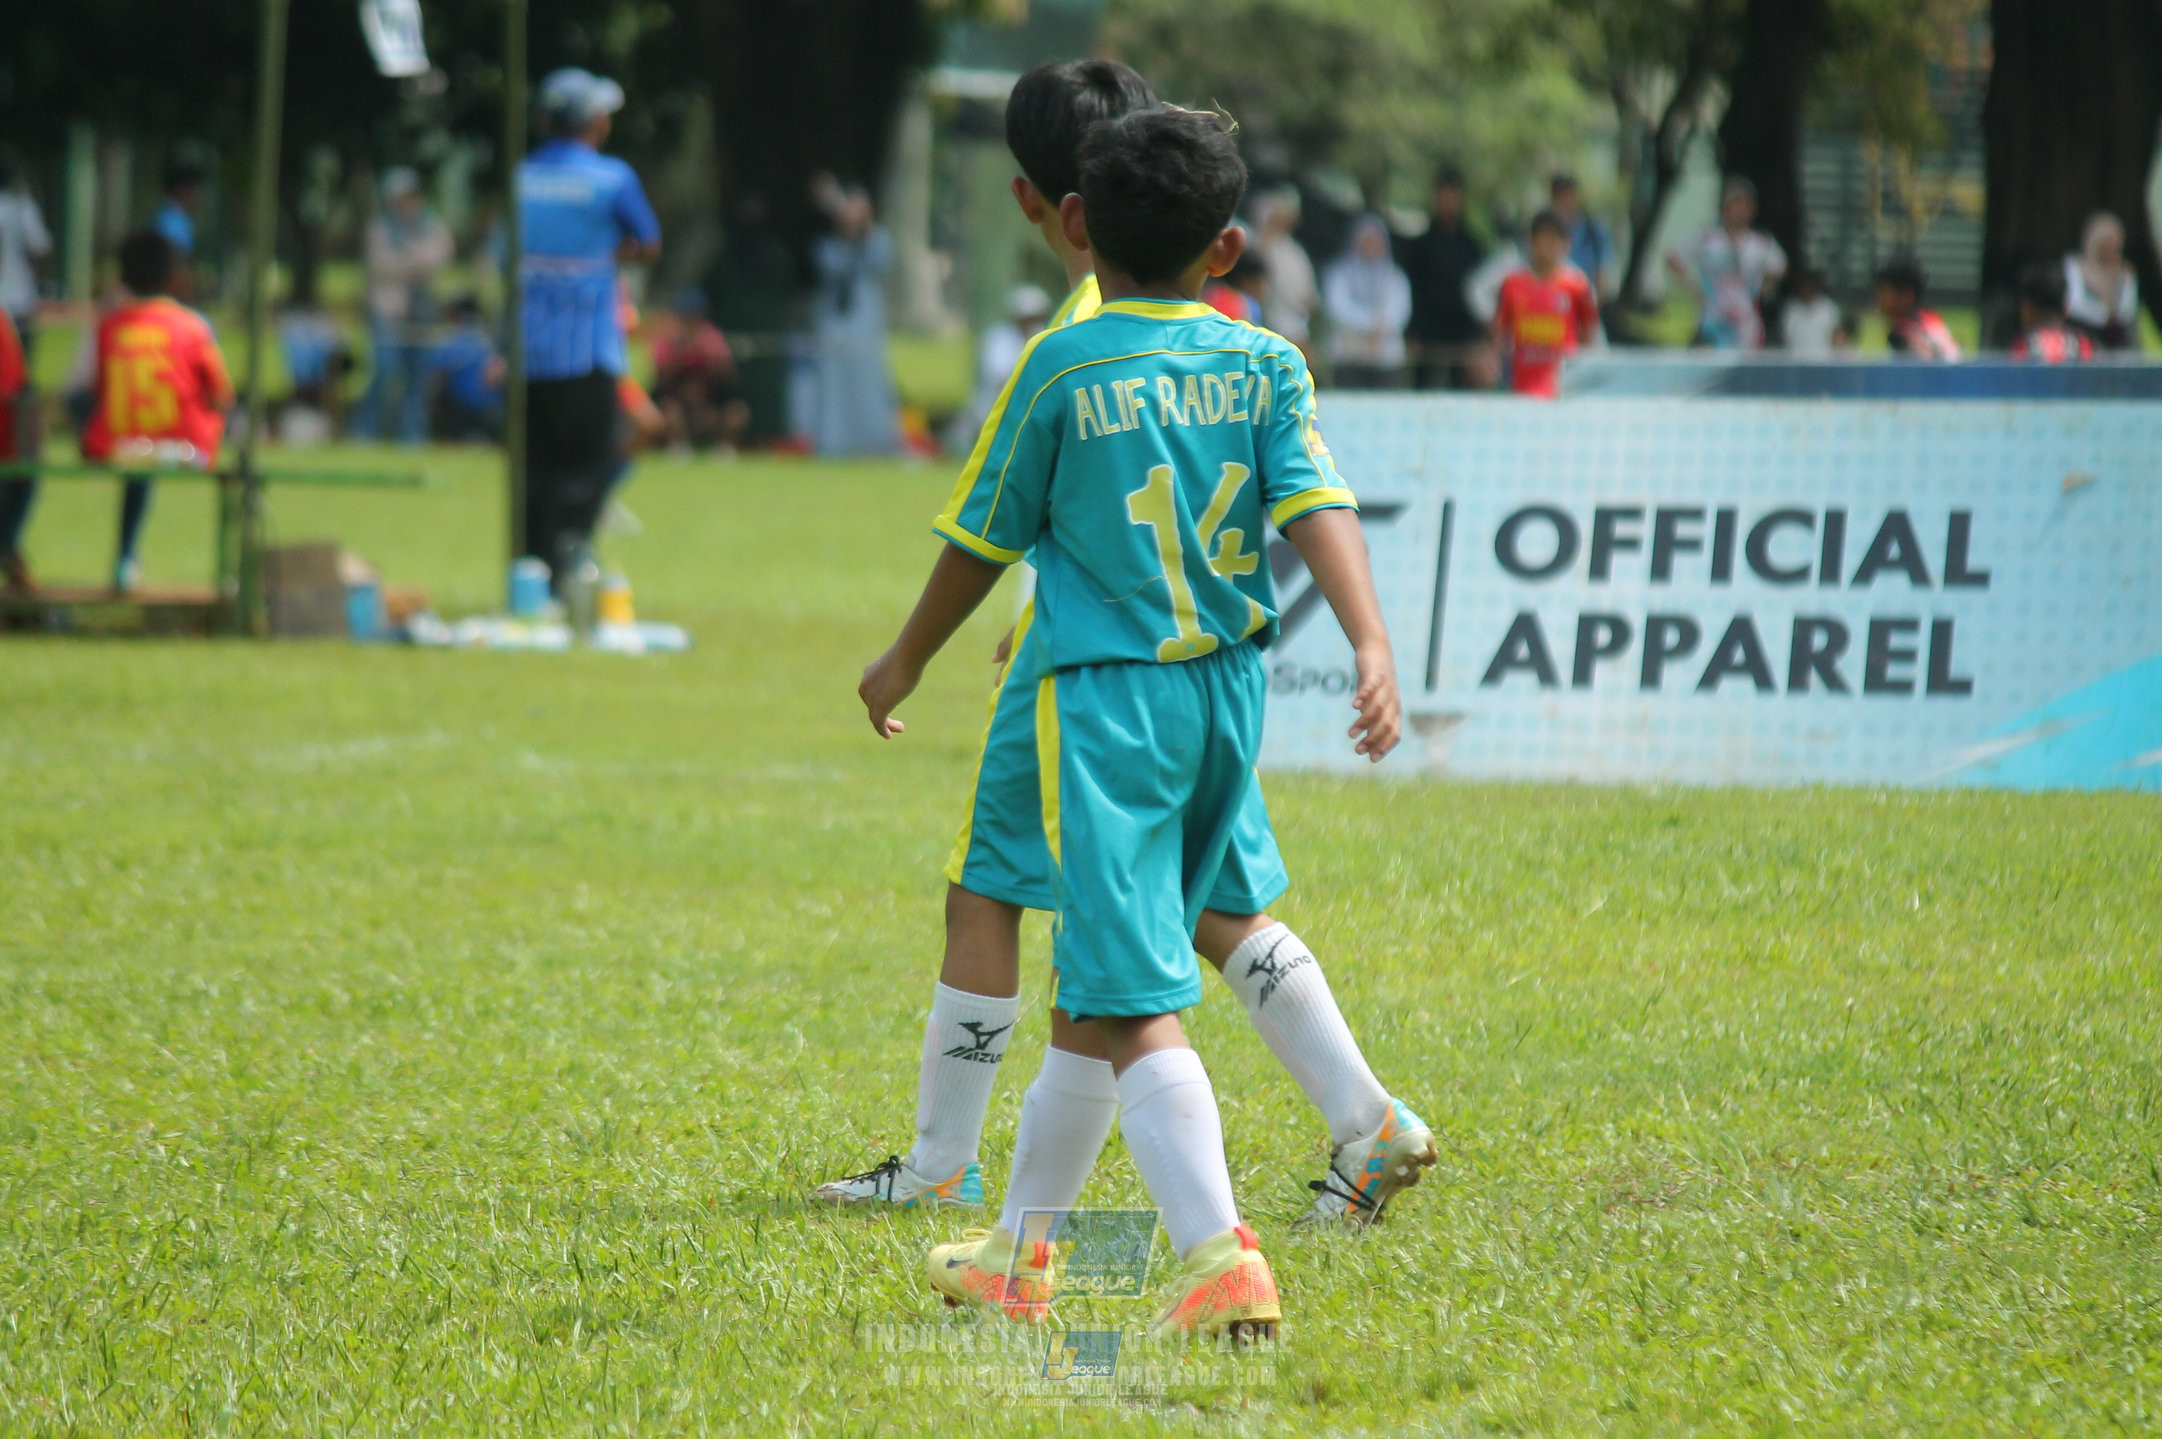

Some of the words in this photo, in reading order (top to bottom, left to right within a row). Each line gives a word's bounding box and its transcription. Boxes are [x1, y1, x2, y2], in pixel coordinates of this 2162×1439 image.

[107, 355, 178, 433] 15
[1074, 377, 1146, 440] ALIF
[1126, 462, 1268, 664] 14
[1494, 504, 1991, 591] OFFICIAL
[1478, 609, 1975, 698] APPAREL
